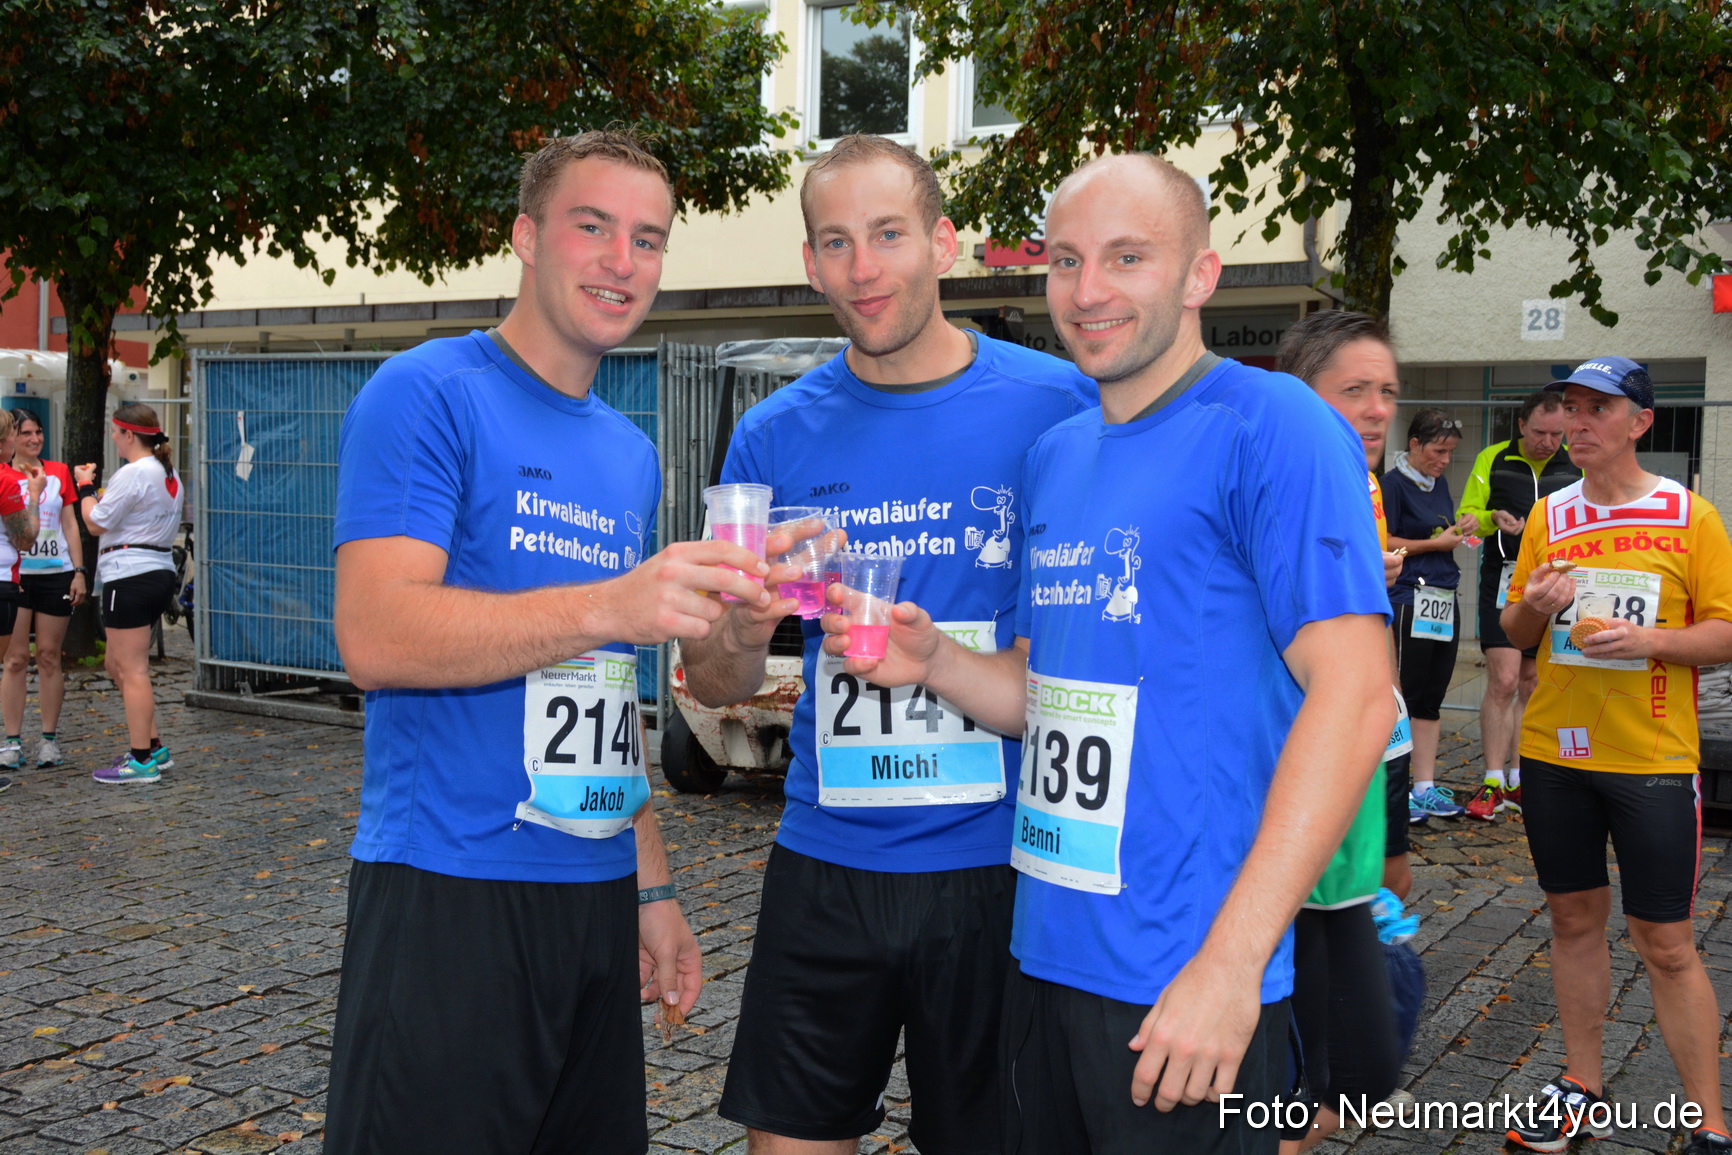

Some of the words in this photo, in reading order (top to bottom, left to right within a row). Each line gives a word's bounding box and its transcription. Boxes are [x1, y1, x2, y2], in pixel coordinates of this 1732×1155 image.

[1528, 308, 1561, 331] 28
[1211, 325, 1285, 347] Labor
[517, 465, 552, 481] JAKO
[809, 482, 850, 498] JAKO
[516, 490, 616, 535] Kirwaläufer
[510, 526, 619, 570] Pettenhofen
[842, 531, 956, 560] ttenhofen
[1613, 531, 1688, 554] BÖGL
[1595, 572, 1649, 588] BOCK
[1420, 598, 1452, 622] 2027
[541, 670, 597, 682] NeuerMarkt
[1041, 684, 1117, 717] BOCK
[544, 696, 640, 766] 2140
[1062, 713, 1084, 723] smart
[1083, 716, 1117, 727] concepts
[871, 753, 939, 780] Michi
[580, 786, 625, 811] Jakob
[1021, 816, 1061, 855] Benni
